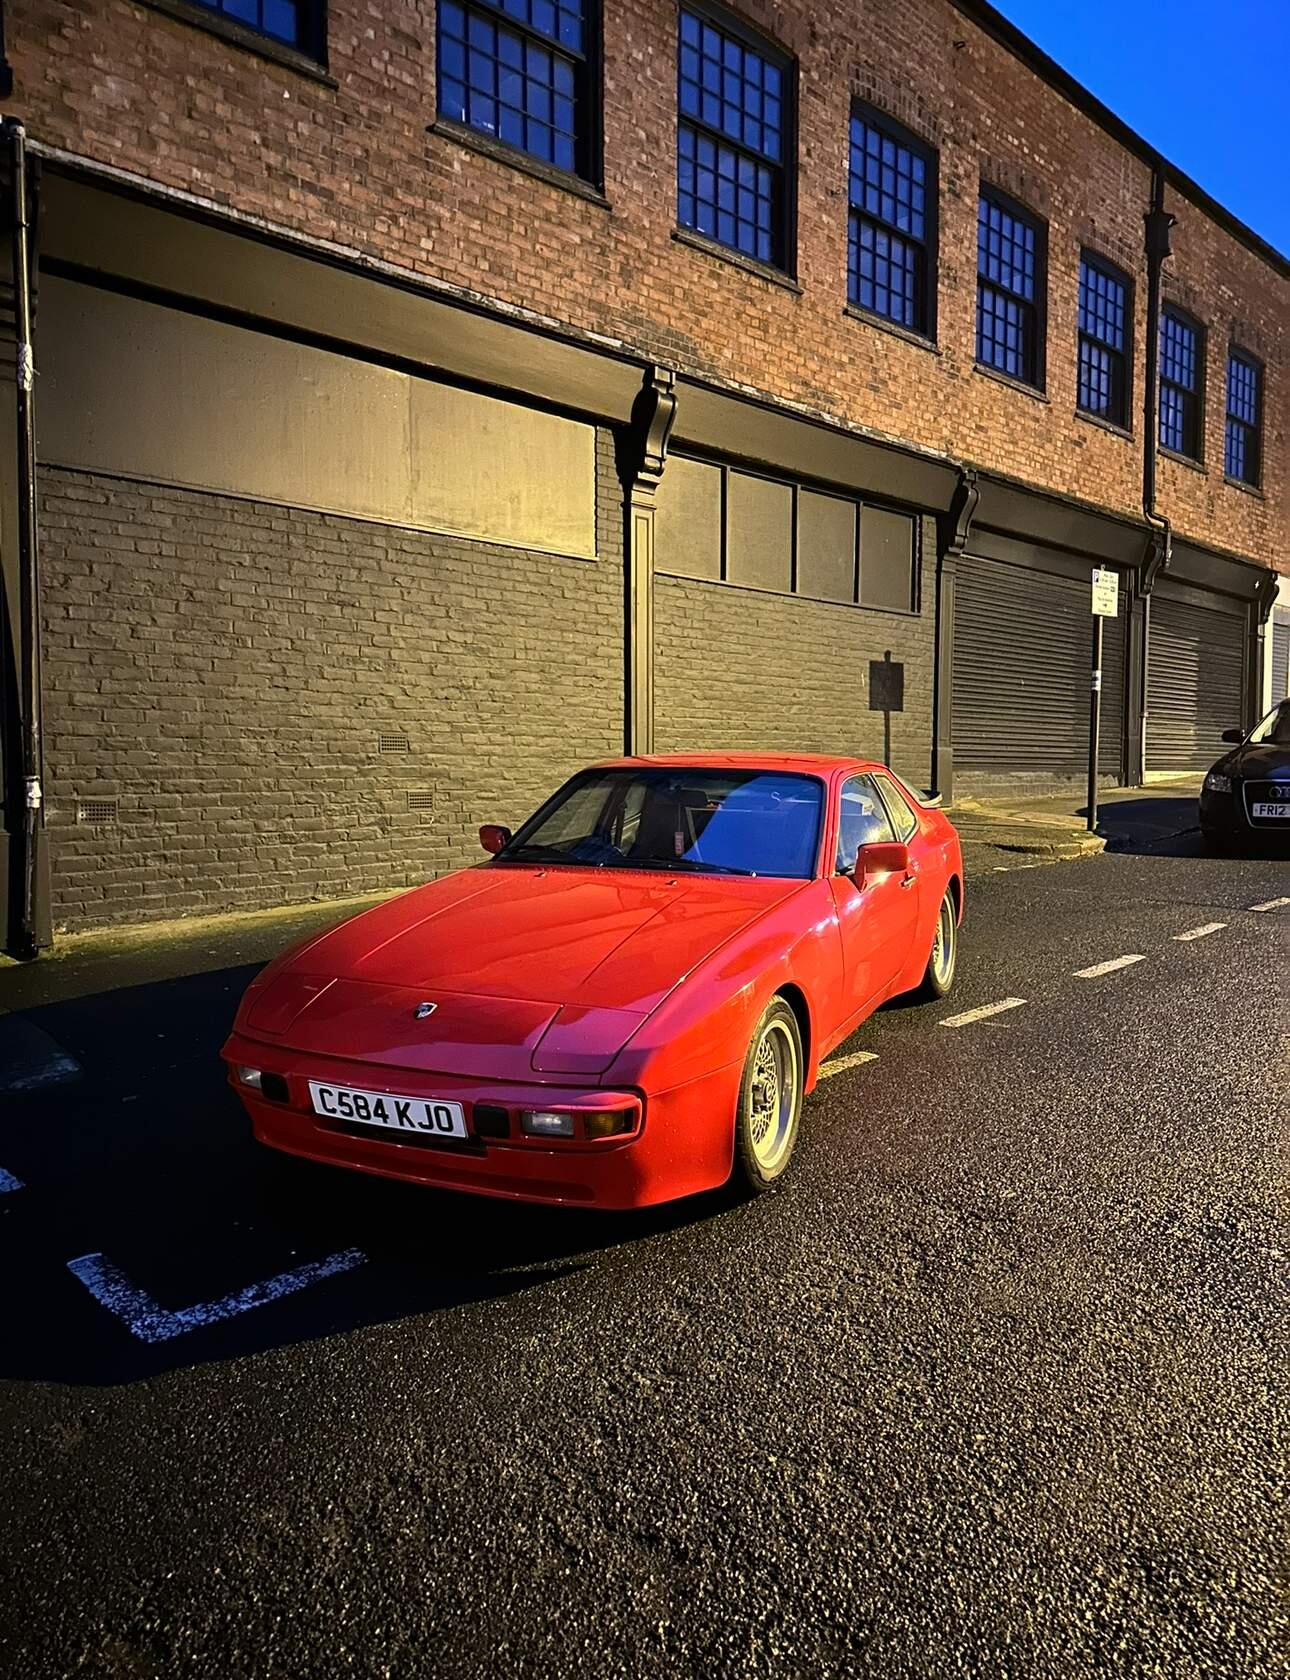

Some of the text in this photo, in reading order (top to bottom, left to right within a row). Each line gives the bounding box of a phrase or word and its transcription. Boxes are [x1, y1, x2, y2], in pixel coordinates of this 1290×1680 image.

[1260, 804, 1286, 816] FR12
[319, 1088, 454, 1133] C584 KJO
